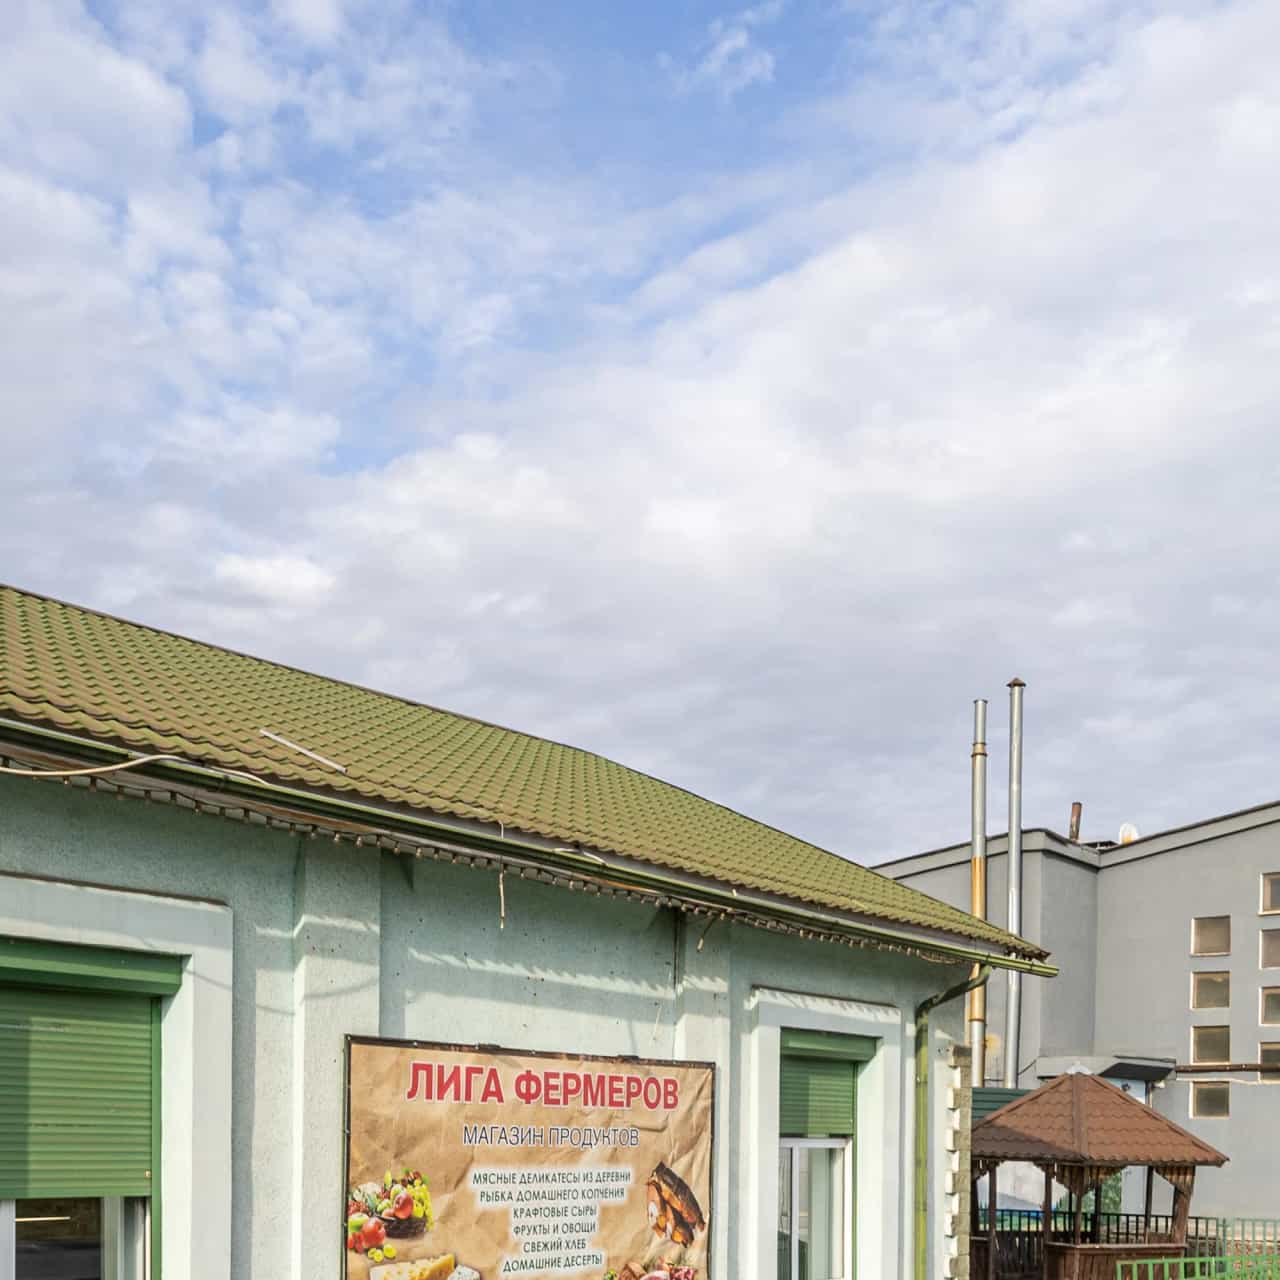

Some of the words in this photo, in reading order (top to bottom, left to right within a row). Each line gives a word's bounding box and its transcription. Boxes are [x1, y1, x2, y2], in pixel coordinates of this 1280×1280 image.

[407, 1062, 505, 1103] ЛИГА
[514, 1069, 680, 1110] ФЕРМЕРОВ
[463, 1125, 544, 1146] МАГАЗИН
[548, 1127, 640, 1148] ПРОДУКТОВ
[473, 1173, 516, 1185] МЯСНЫЕ
[519, 1172, 580, 1185] ДЕЛИКАТЕСЫ
[583, 1172, 593, 1183] ИЗ
[595, 1171, 631, 1183] ДЕРЕВНИ
[480, 1190, 513, 1202] РЫБКА
[517, 1189, 579, 1202] ДОМАШНЕГО
[581, 1187, 625, 1199] КОПЧЕНИЯ
[513, 1206, 568, 1218] КРАФТОВЫЕ
[571, 1205, 597, 1217] СЫРЫ
[513, 1223, 550, 1236] ФРУКТЫ
[553, 1223, 559, 1234] И
[561, 1222, 596, 1234] ОВОЩИ
[523, 1238, 562, 1253] СВЕЖИЙ
[564, 1239, 586, 1250] ХЛЕБ
[503, 1257, 562, 1273] ДОМАШНИЕ
[564, 1254, 602, 1268] ДЕСЕРТЫ
